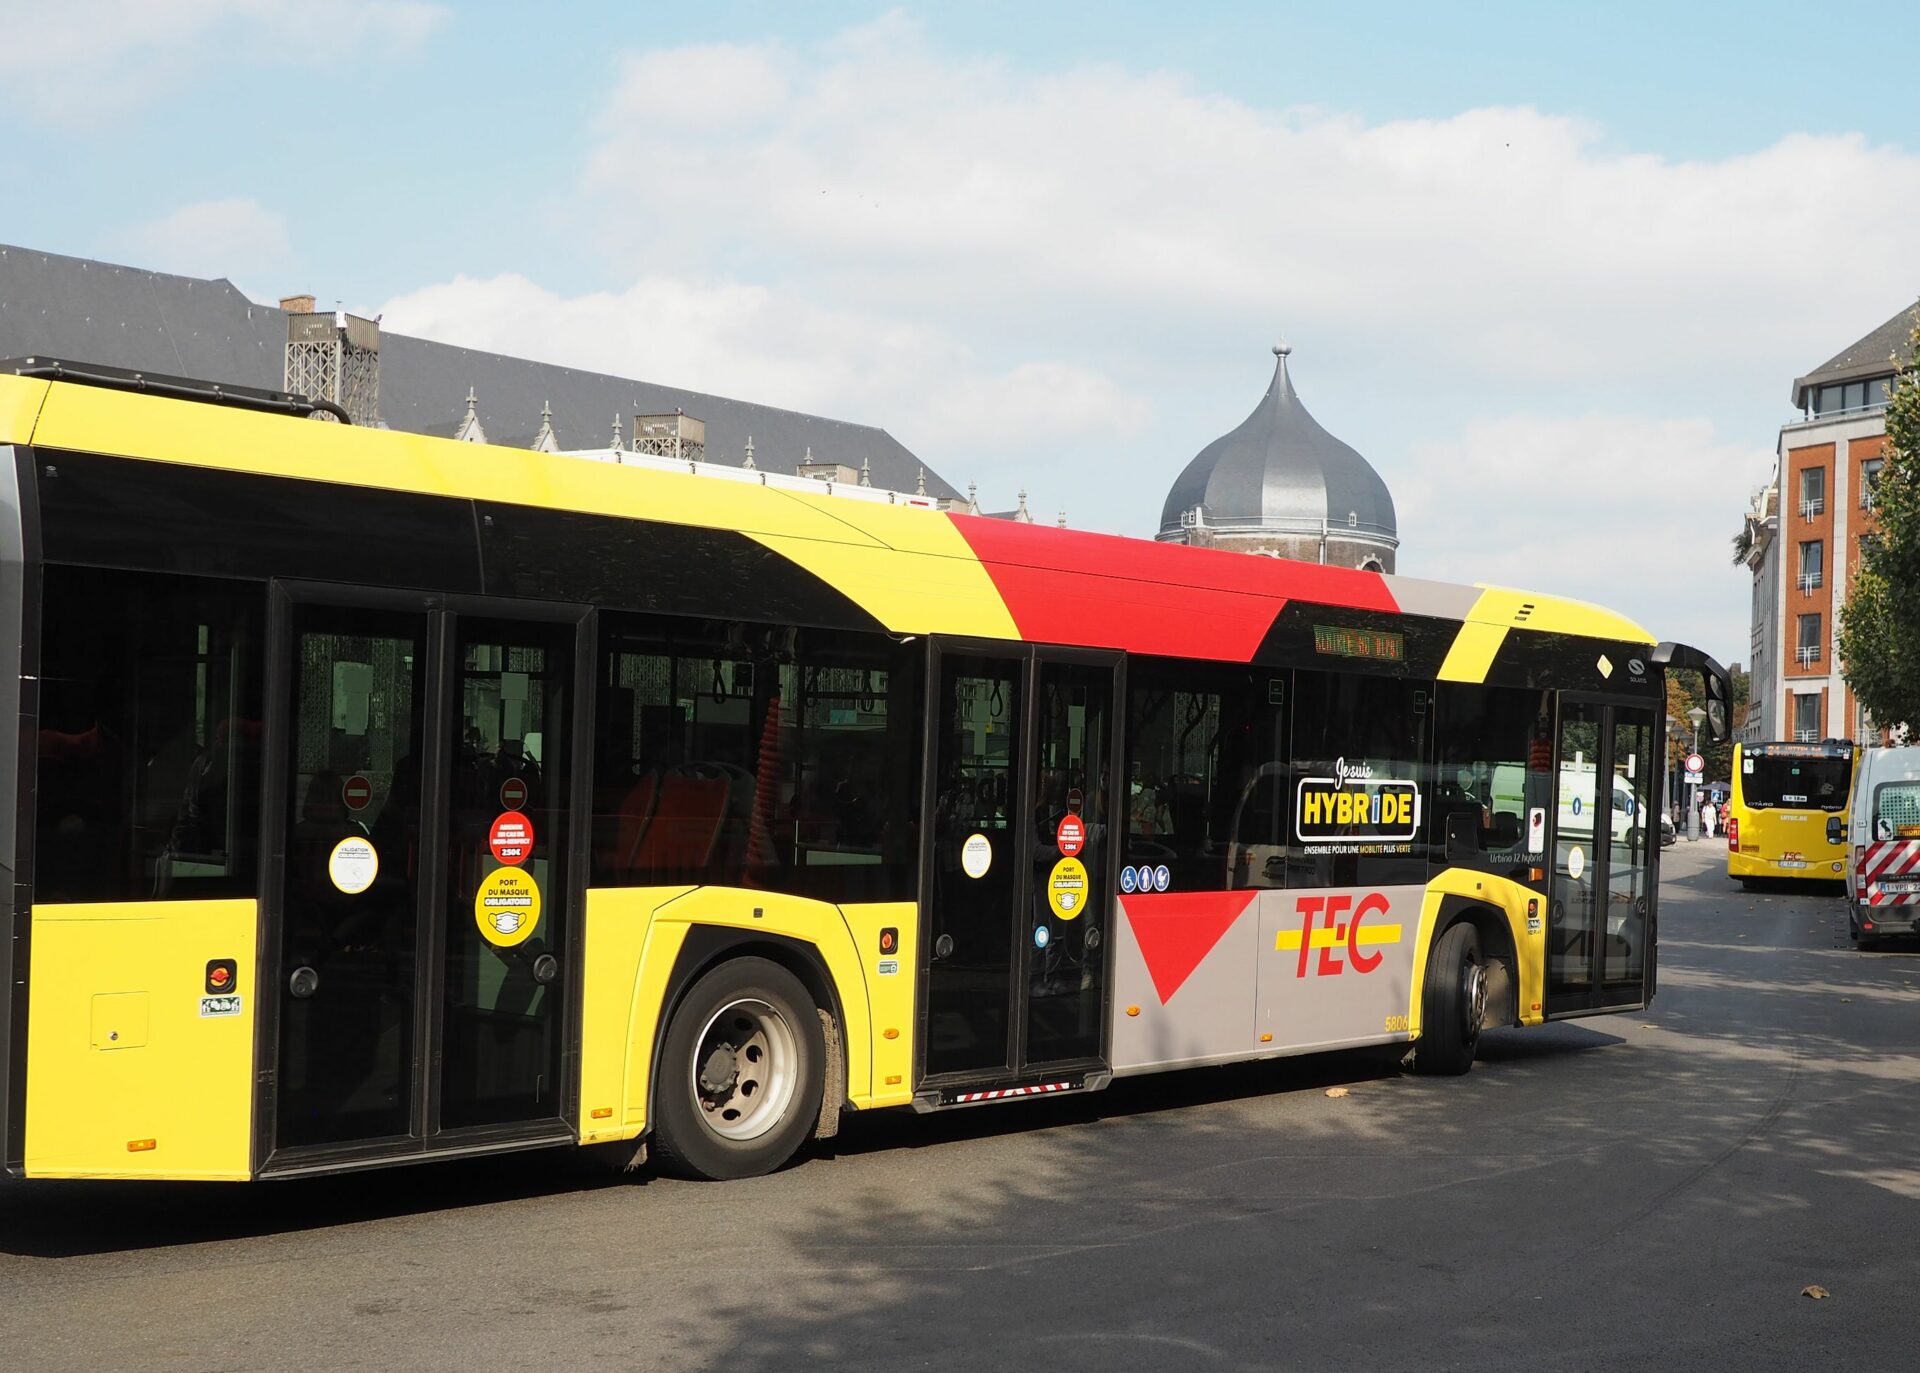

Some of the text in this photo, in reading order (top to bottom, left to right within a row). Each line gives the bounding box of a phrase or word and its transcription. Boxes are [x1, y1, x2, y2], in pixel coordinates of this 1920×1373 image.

[501, 848, 521, 856] 250€
[1304, 844, 1411, 854] ENSEMBLE POUR UNE MOBILITÉ PLUS VERTE
[1490, 853, 1543, 865] Urbino 12 hybrid
[500, 888, 529, 896] MASQUE
[485, 898, 531, 906] OBLIGATOIRE
[1296, 893, 1390, 978] TEC
[1384, 1015, 1408, 1032] 5806
